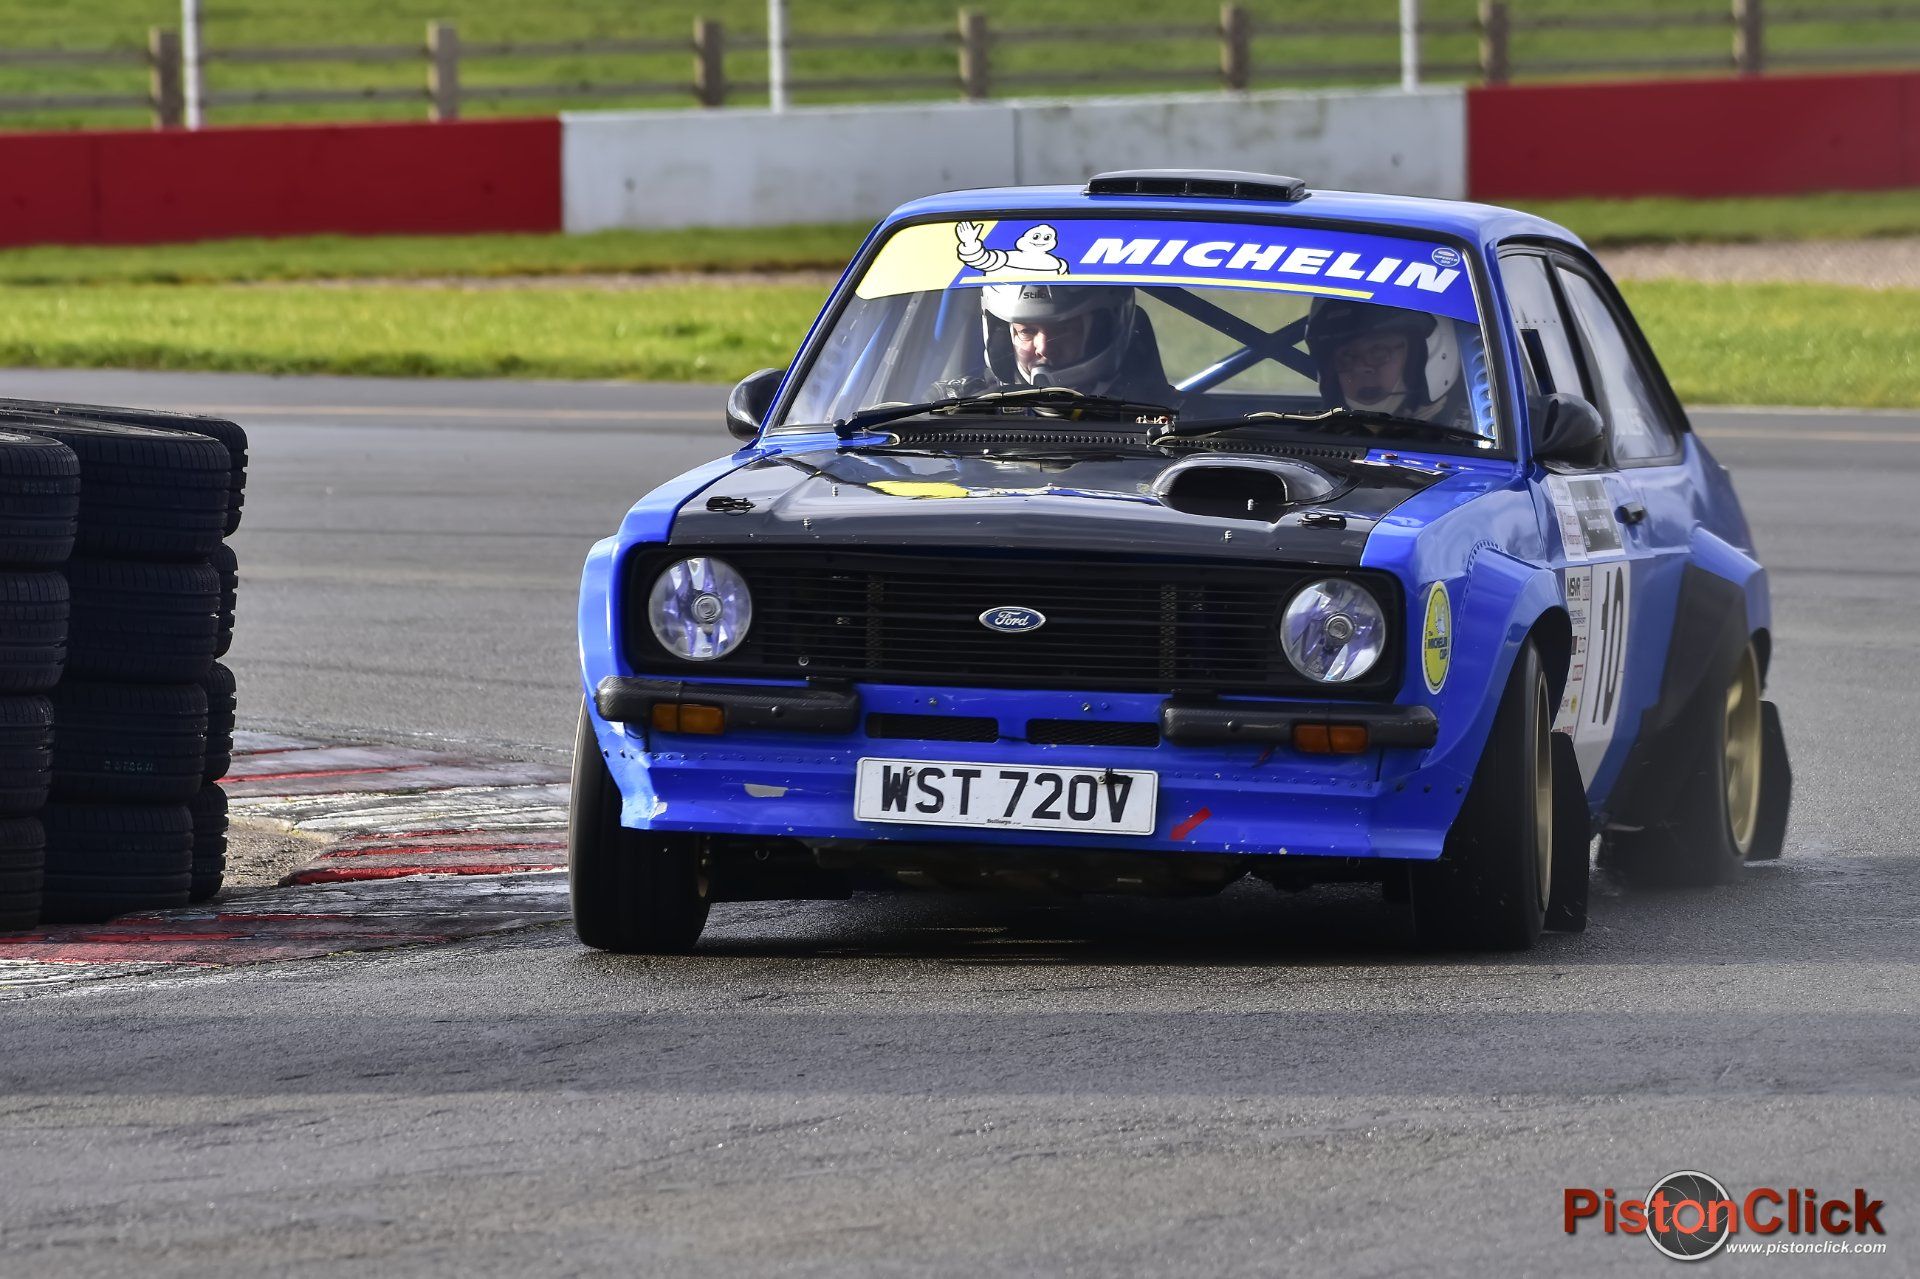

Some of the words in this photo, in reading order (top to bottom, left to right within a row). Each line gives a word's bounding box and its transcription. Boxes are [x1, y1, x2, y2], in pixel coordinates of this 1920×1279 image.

[1080, 236, 1460, 294] MICHELIN
[1022, 289, 1048, 300] Stilo
[995, 611, 1029, 626] Ford
[881, 765, 981, 815] WST
[999, 769, 1134, 823] 720V
